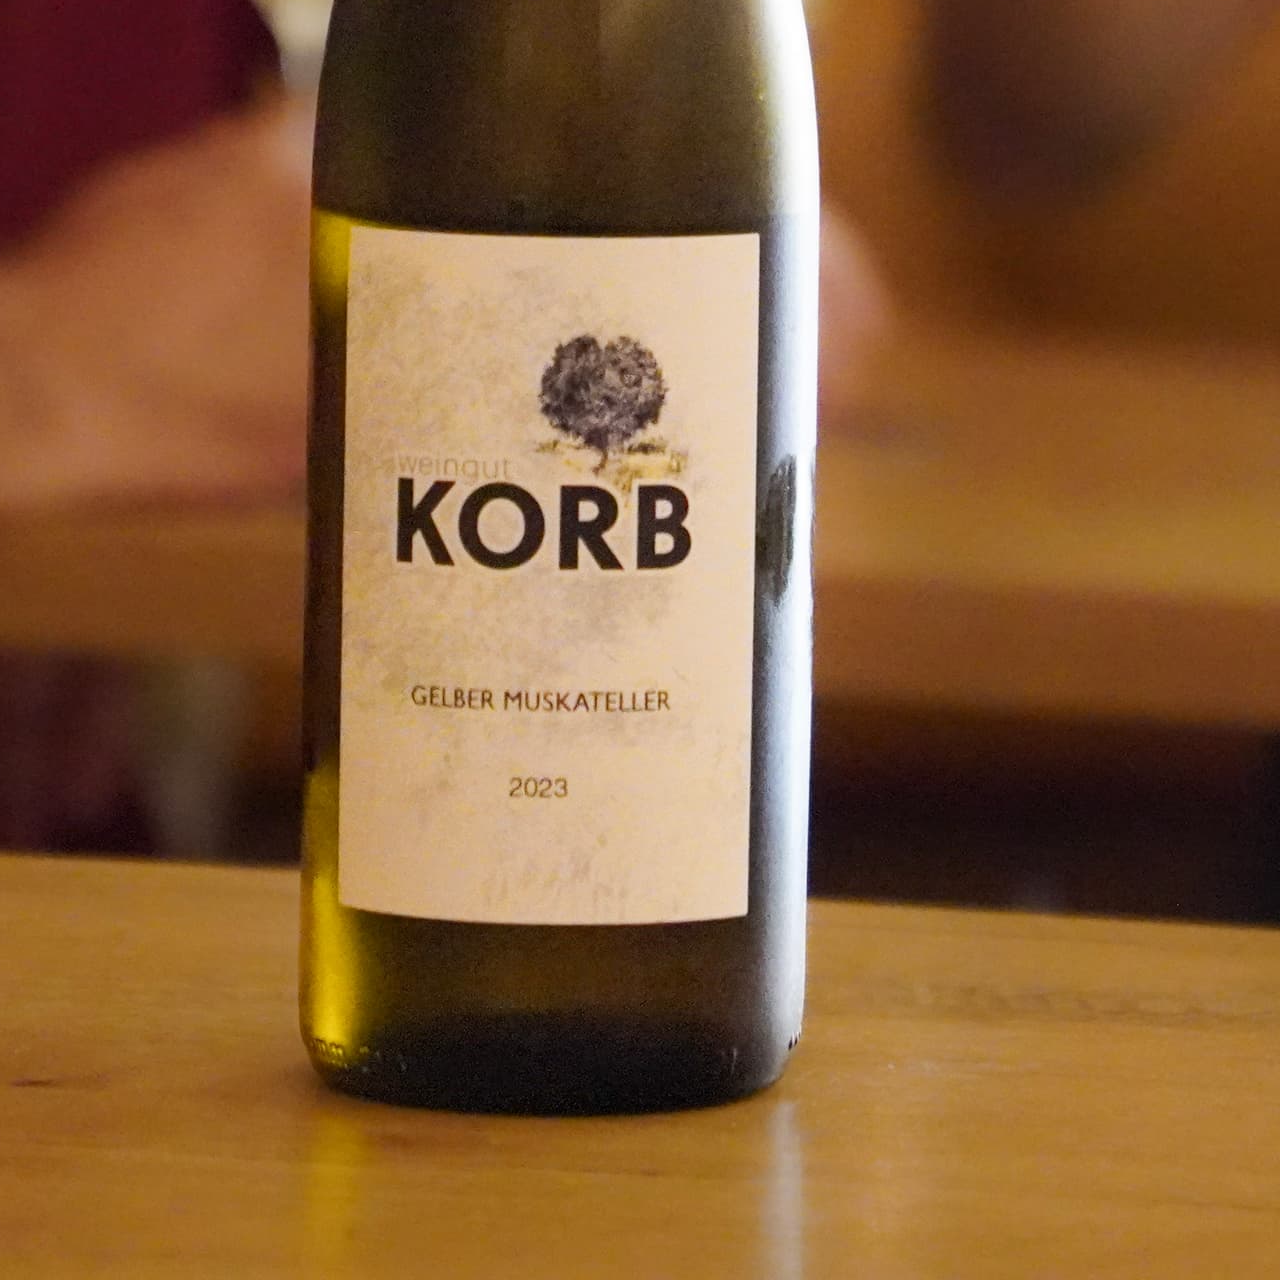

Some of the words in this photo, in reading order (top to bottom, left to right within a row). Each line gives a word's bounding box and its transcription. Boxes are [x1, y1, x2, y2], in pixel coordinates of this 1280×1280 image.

[397, 453, 510, 482] weingut
[396, 477, 692, 571] KORB
[411, 684, 494, 711] GELBER
[503, 689, 671, 713] MUSKATELLER
[509, 776, 569, 799] 2023
